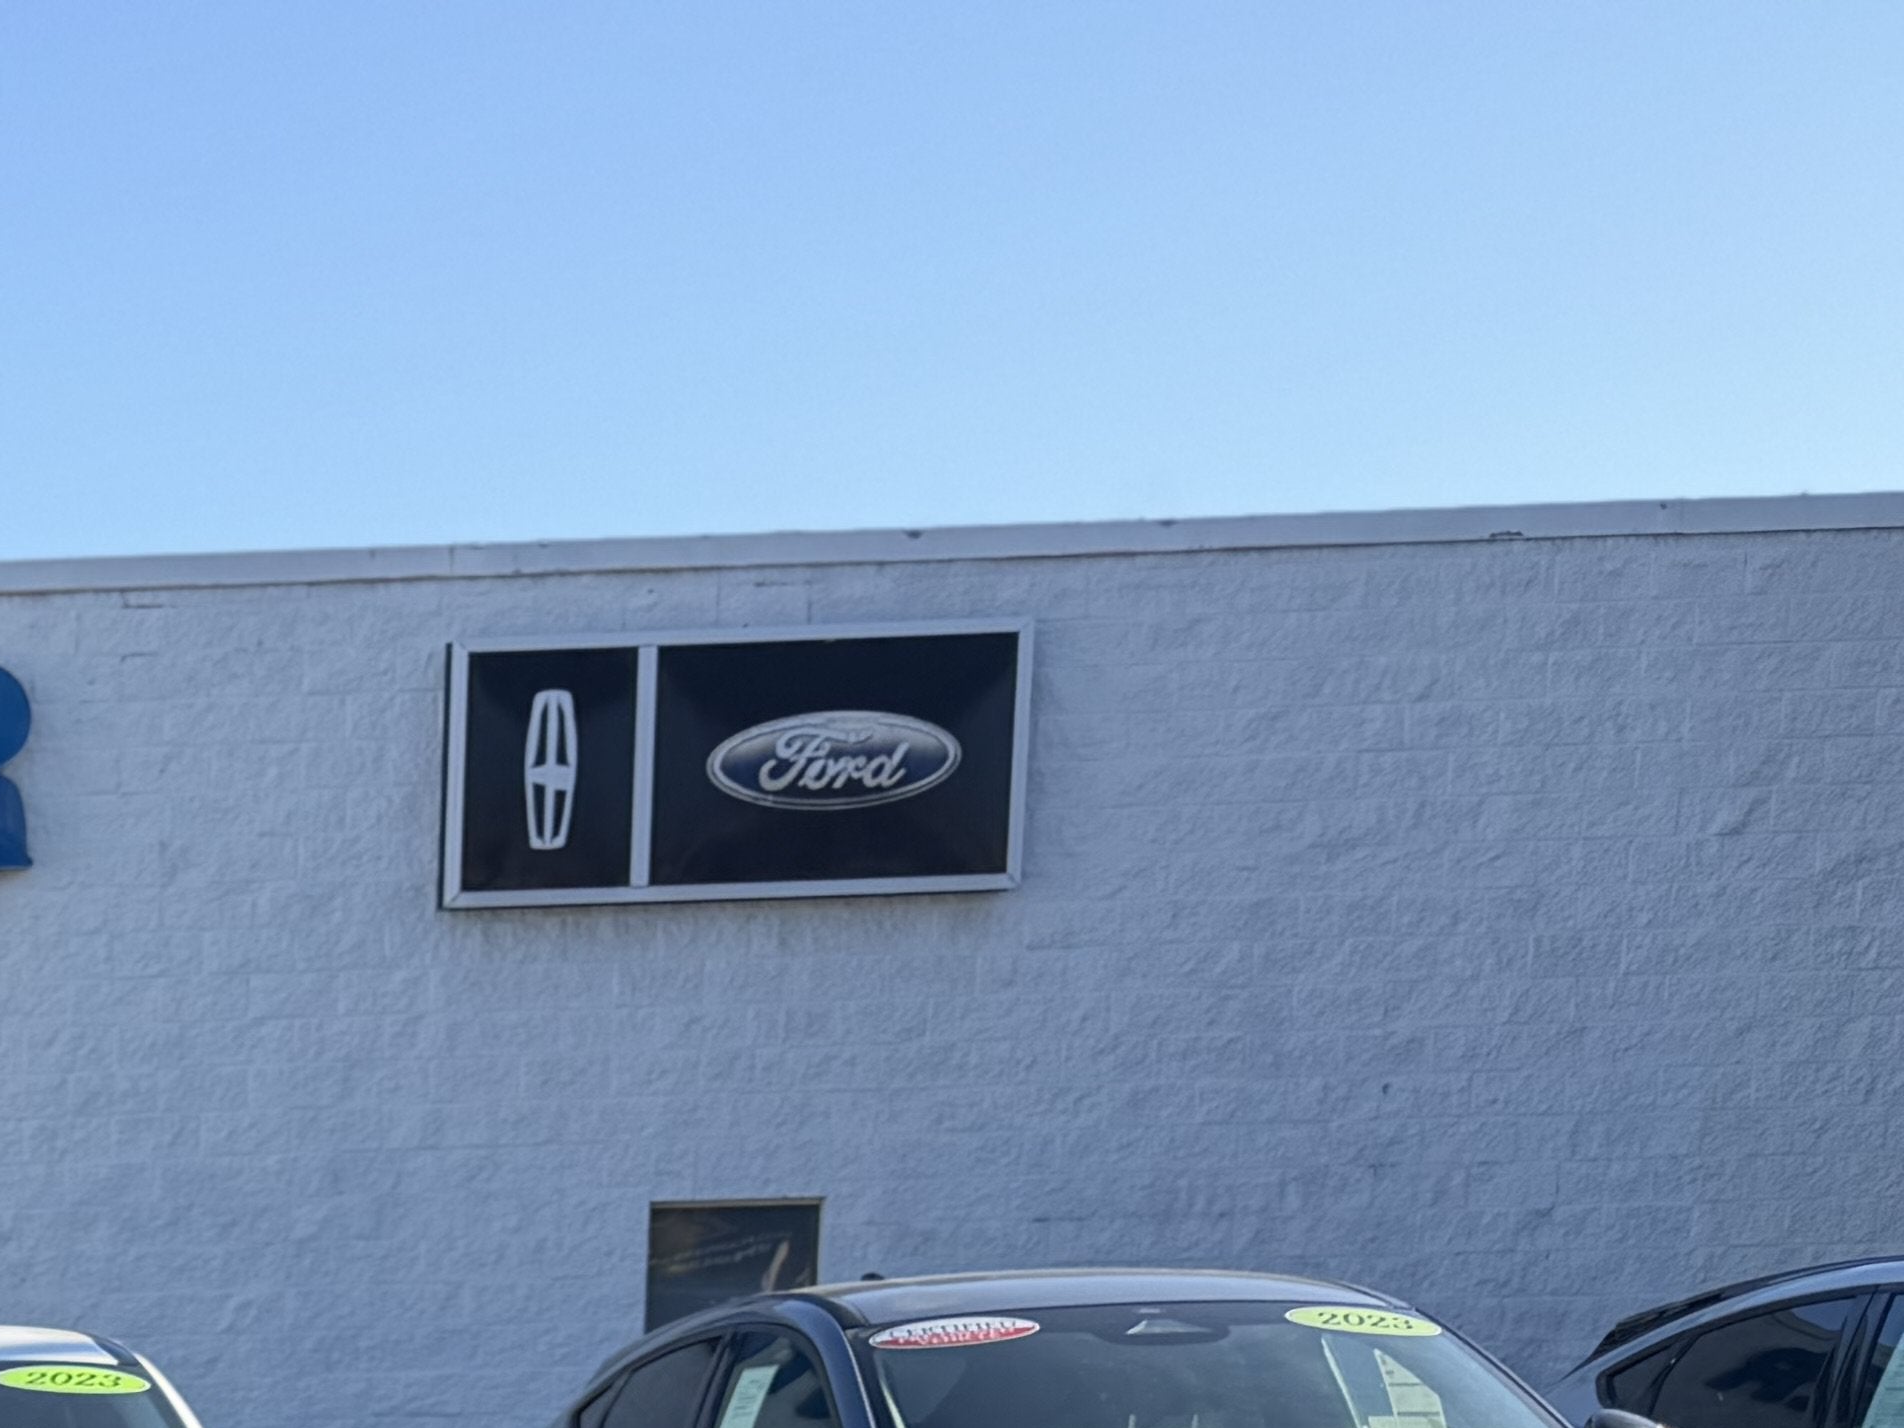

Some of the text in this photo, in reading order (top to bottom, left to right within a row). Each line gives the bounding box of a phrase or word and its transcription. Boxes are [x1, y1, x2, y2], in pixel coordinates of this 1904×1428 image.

[758, 726, 909, 791] Ford
[1317, 1311, 1413, 1330] 2023
[24, 1371, 123, 1388] 2023
